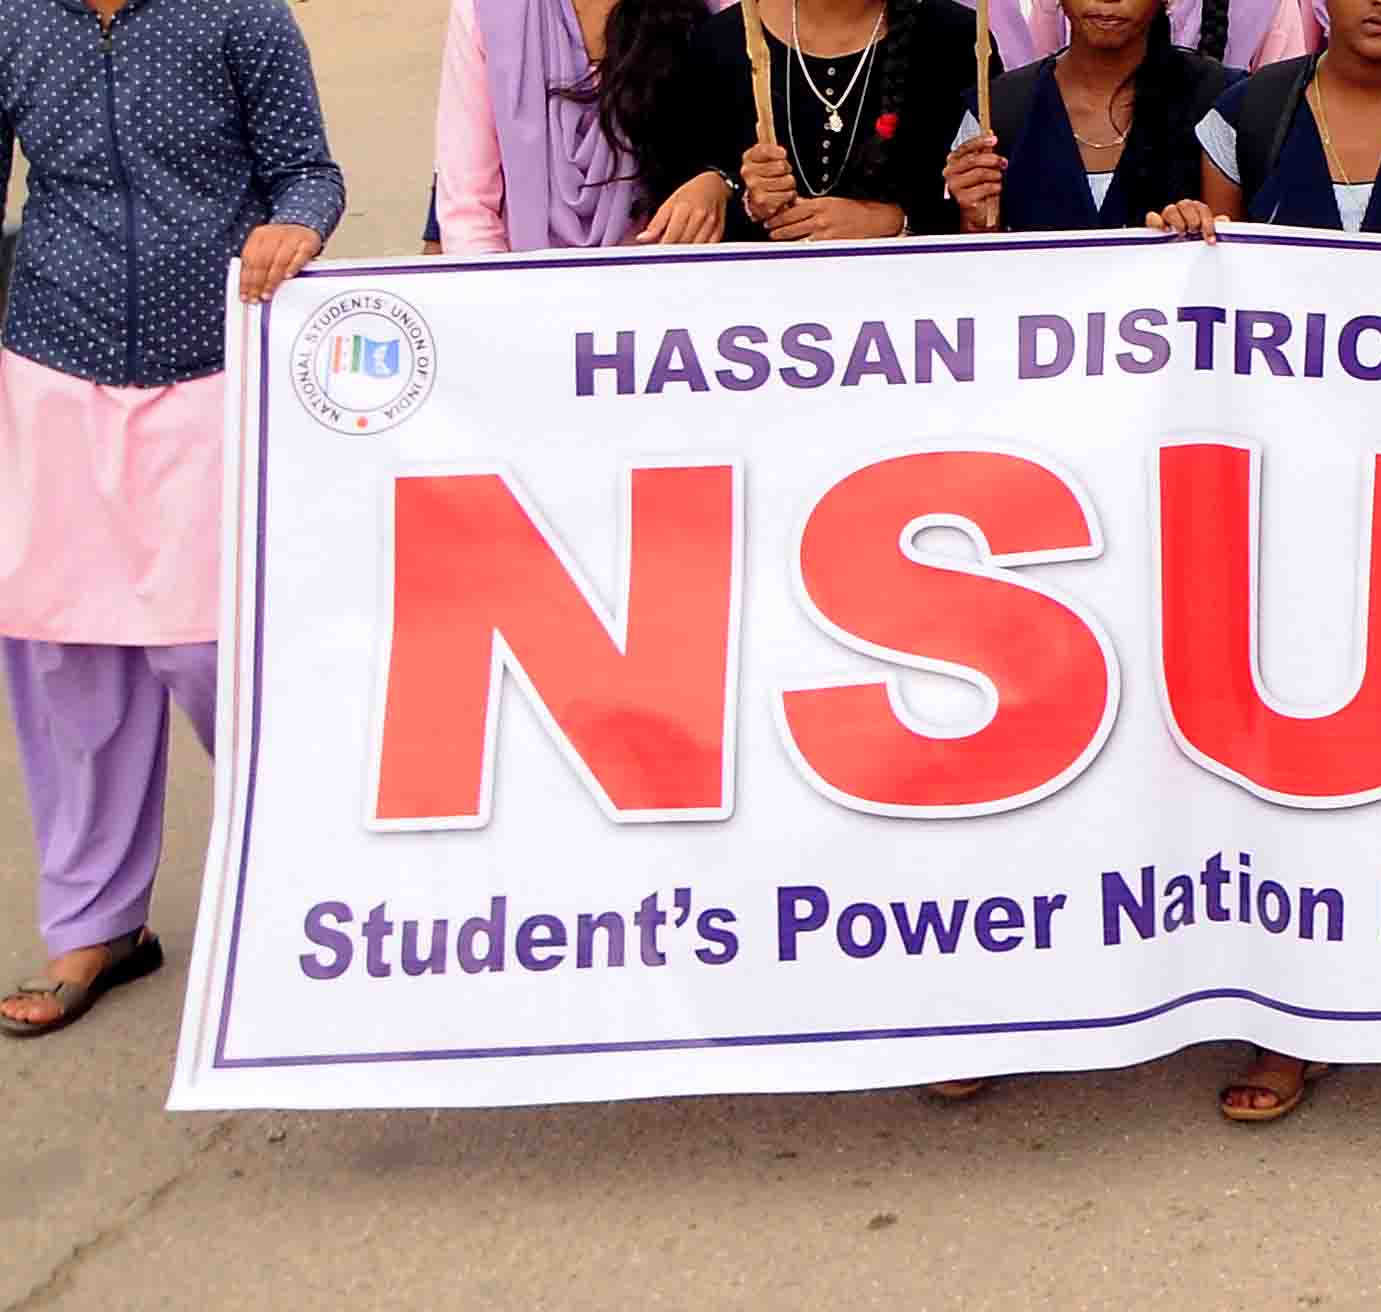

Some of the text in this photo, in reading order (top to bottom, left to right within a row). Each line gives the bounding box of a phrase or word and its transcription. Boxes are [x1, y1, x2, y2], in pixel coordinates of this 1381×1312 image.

[391, 305, 428, 350] UNION
[576, 320, 974, 396] HASSAN
[384, 383, 422, 419] INDIA
[778, 886, 1067, 960] Power
[1103, 852, 1345, 944] Nation
